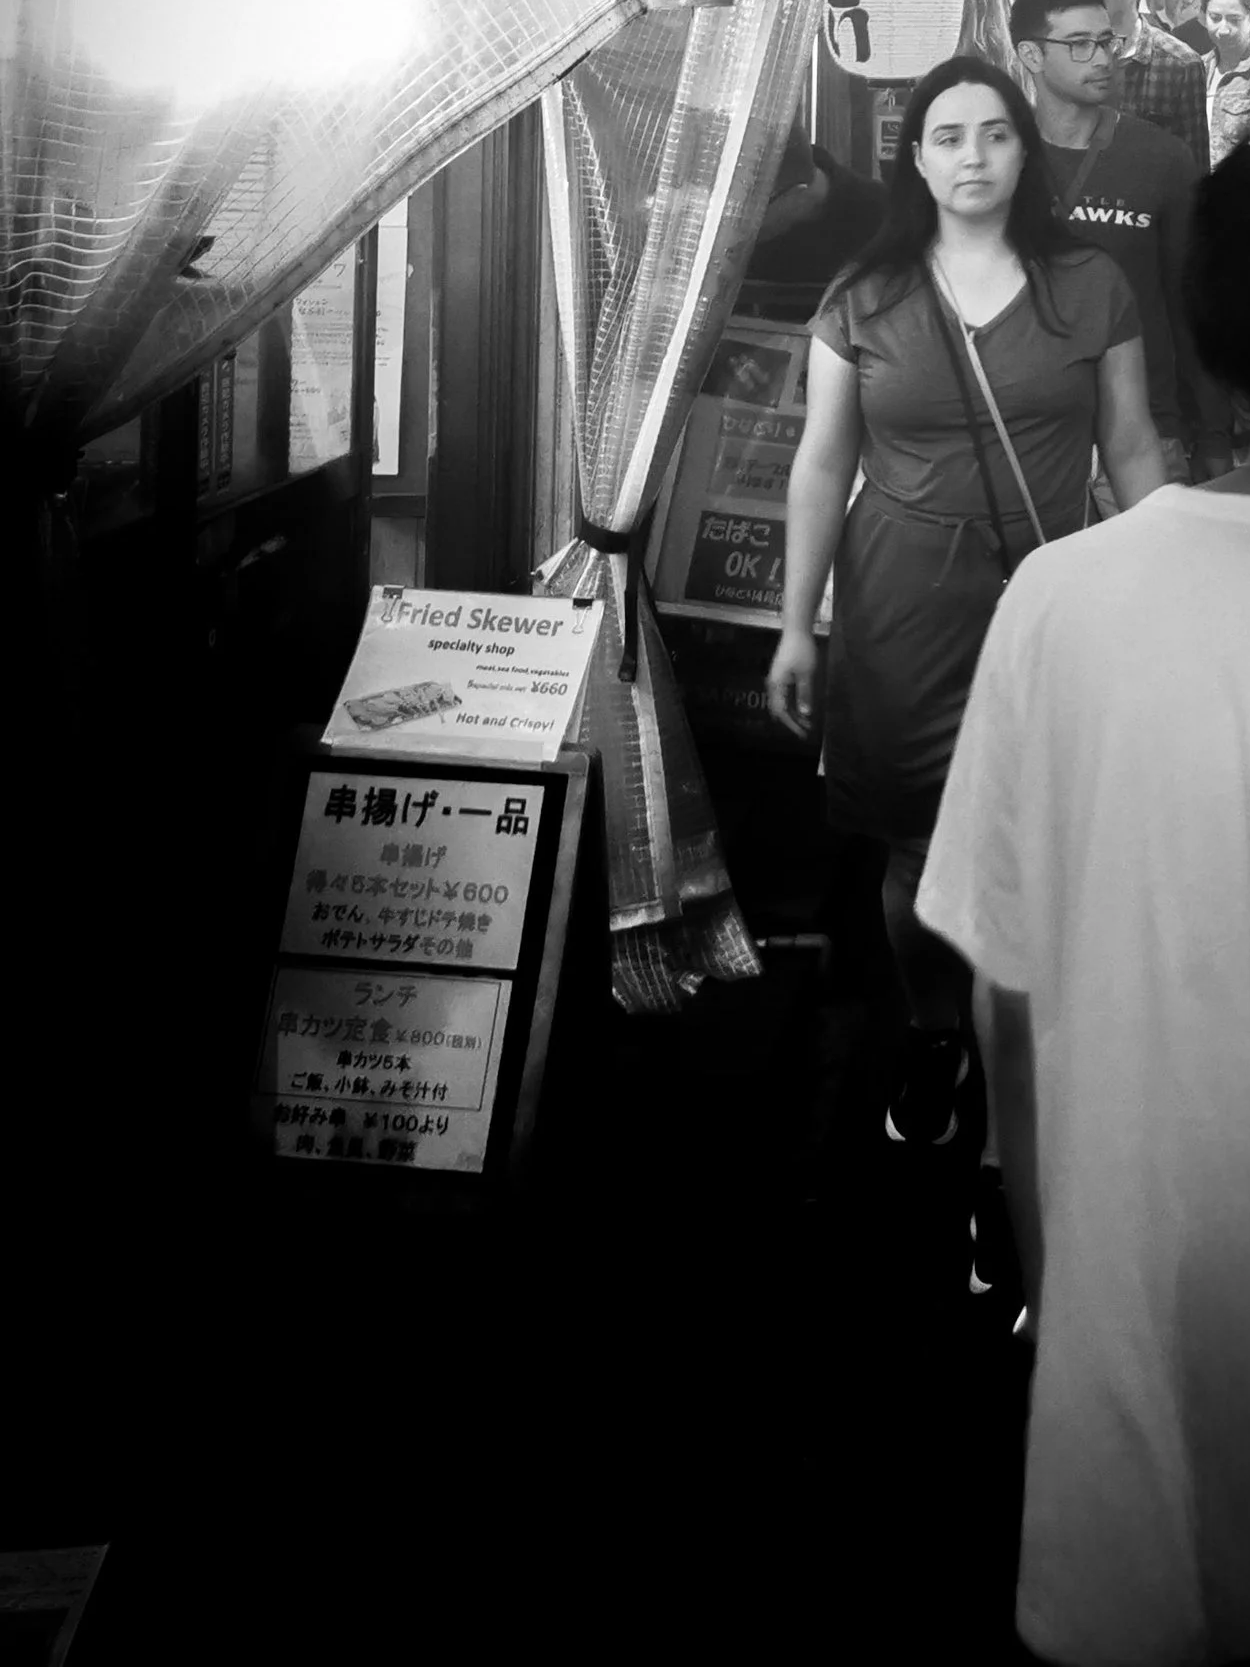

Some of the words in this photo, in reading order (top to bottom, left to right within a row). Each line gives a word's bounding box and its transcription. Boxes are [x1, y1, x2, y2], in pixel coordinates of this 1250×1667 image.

[1068, 206, 1152, 228] AWKS
[700, 516, 769, 545] たばこ
[399, 602, 461, 626] Fried
[467, 608, 562, 635] Skewer
[427, 637, 481, 653] specialty
[485, 642, 514, 655] shop
[530, 681, 567, 695] ¥660
[456, 712, 478, 725] Hot
[482, 715, 504, 727] and
[324, 783, 528, 835] 串揚げ・一品
[380, 842, 446, 867] 串揚げ
[354, 982, 416, 1006] ランチ
[336, 1049, 410, 1071] 串カツ5本
[362, 1112, 448, 1136] ¥100より
